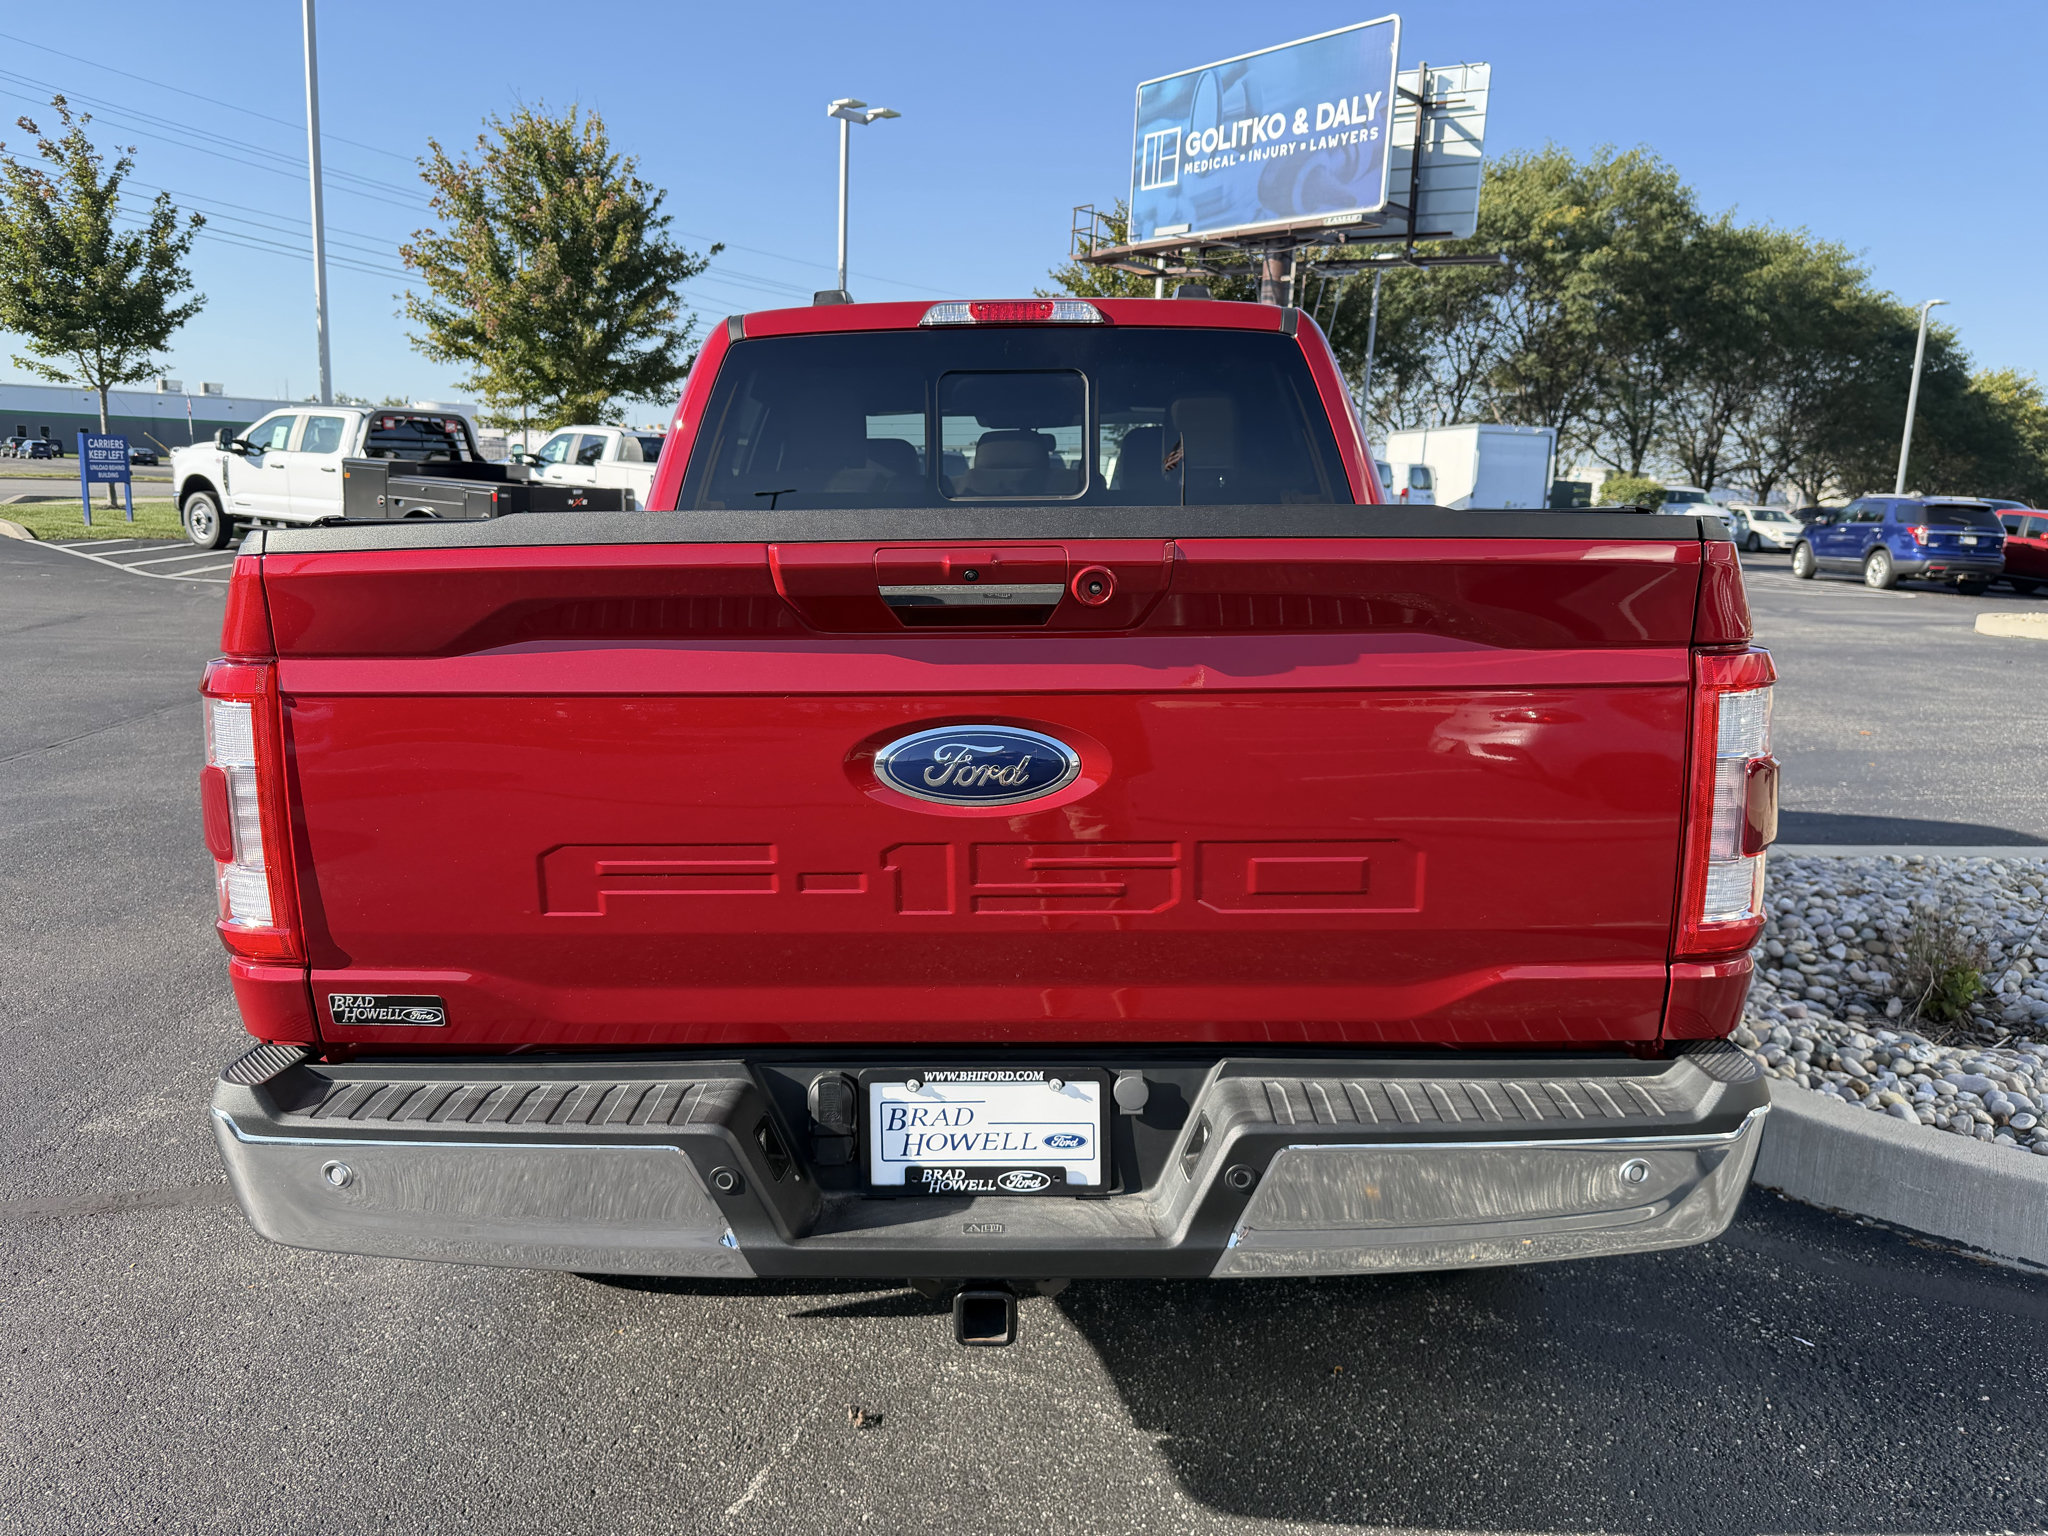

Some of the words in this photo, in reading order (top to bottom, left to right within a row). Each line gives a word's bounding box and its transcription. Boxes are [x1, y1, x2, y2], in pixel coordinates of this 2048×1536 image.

[1185, 112, 1287, 157] GOLITKO
[1292, 107, 1309, 136] &
[1316, 91, 1382, 132] DALY
[1184, 155, 1236, 175] MEDICAL
[1248, 141, 1297, 163] INJURY
[1309, 127, 1379, 152] LAWYERS
[88, 438, 124, 449] CARRIERS
[89, 450, 107, 459] KEEP
[108, 450, 124, 459] LEFT
[923, 743, 1032, 787] Ford
[537, 839, 1427, 916] F-150
[333, 996, 375, 1011] BRAD
[342, 1008, 402, 1022] HOWELL
[409, 1010, 435, 1020] Ford
[924, 1071, 1044, 1082] WWW.BHIFORD.COM
[886, 1107, 974, 1131] BRAD
[900, 1131, 1038, 1157] HOWELL
[1050, 1135, 1080, 1148] Ford
[921, 1169, 966, 1183] BRAD
[928, 1179, 996, 1193] HOWELL
[1006, 1173, 1042, 1189] Ford
